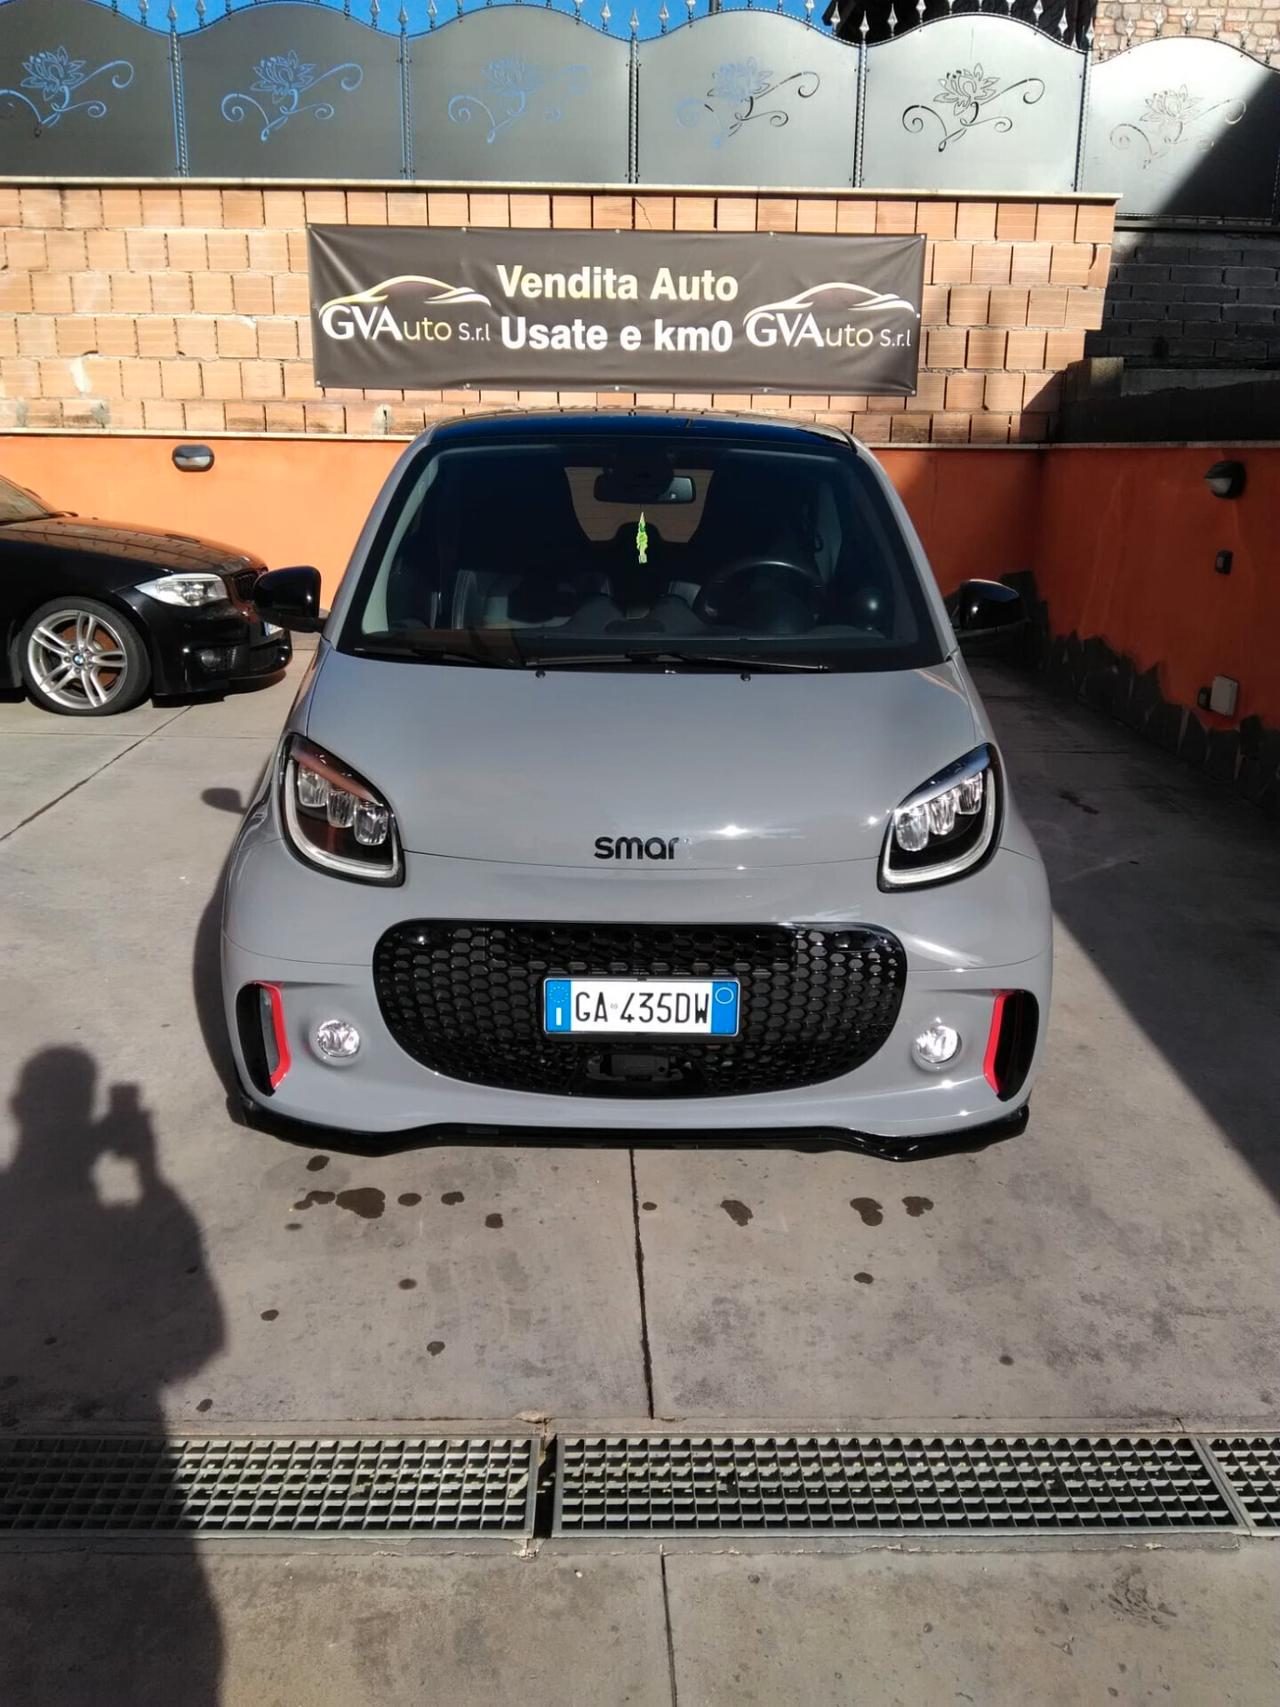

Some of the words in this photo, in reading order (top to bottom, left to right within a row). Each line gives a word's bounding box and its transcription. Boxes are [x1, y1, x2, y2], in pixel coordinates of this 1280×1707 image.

[496, 264, 638, 300] Vendita
[650, 267, 738, 301] Auto
[500, 316, 608, 350] Usate
[620, 325, 642, 350] e
[654, 319, 733, 352] km0
[594, 836, 681, 860] smar
[575, 991, 608, 1022] GA
[620, 992, 710, 1024] 435DW
